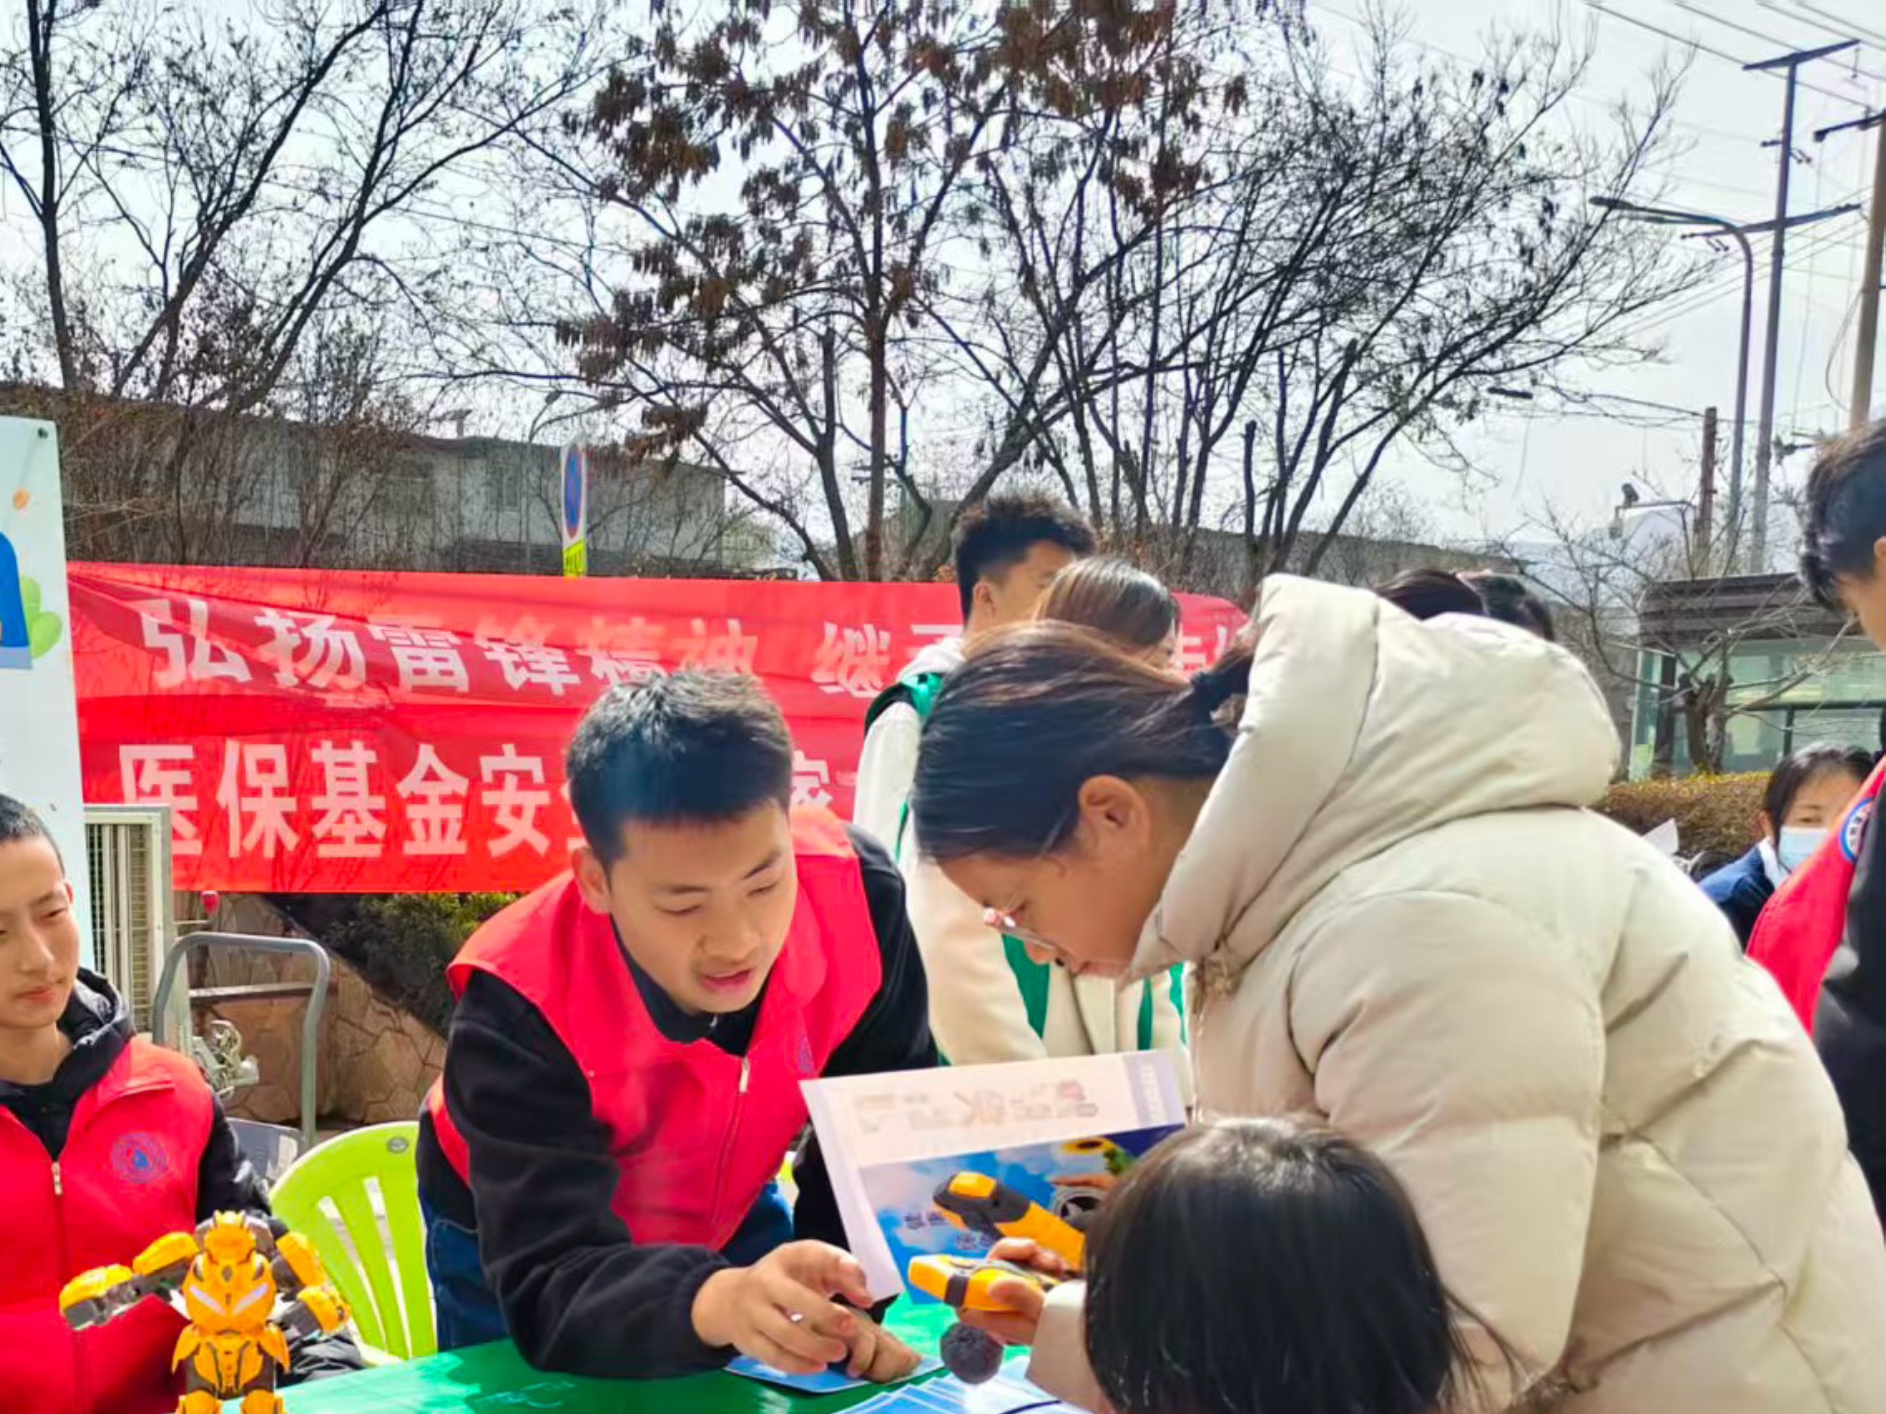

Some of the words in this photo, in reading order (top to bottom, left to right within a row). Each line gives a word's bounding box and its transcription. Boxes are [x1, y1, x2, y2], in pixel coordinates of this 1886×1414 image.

[117, 738, 580, 862] 医保基金安
